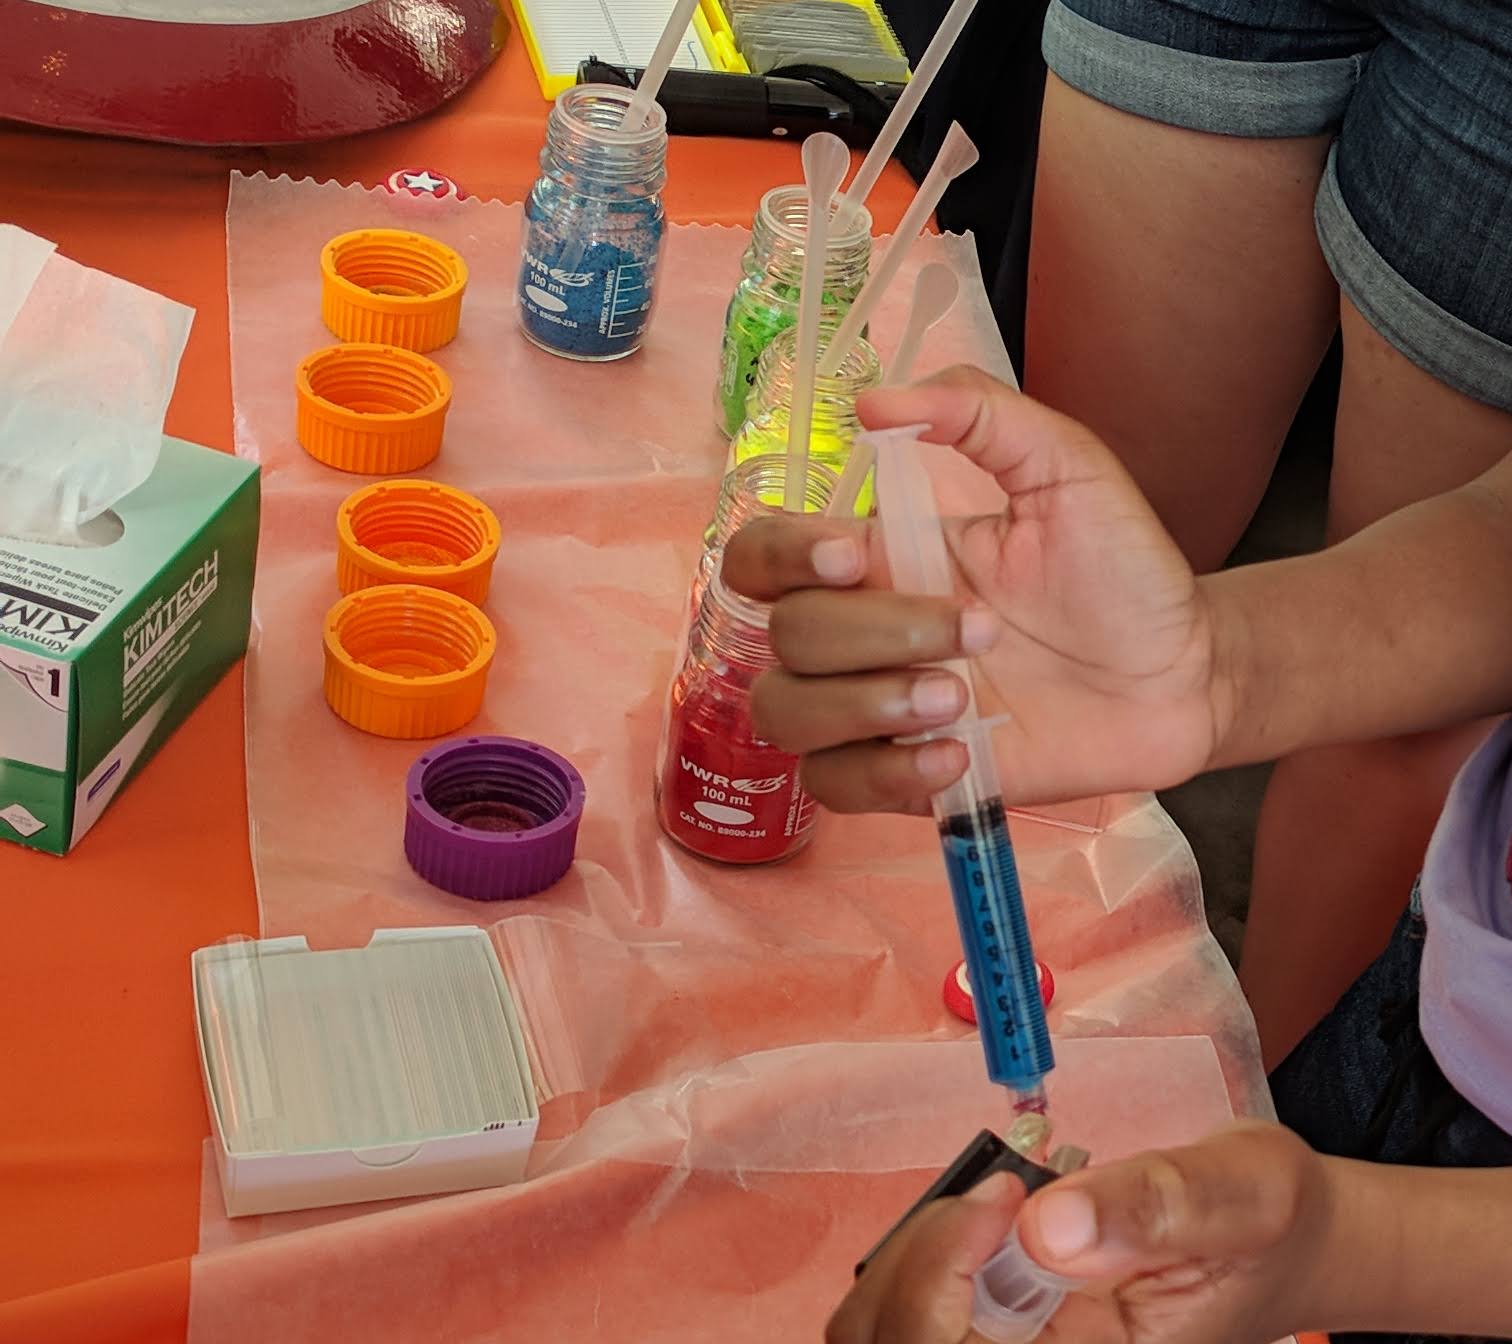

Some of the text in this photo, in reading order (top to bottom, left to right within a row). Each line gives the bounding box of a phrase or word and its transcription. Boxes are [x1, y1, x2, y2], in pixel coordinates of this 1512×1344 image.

[530, 271, 566, 296] 100 mL
[36, 582, 60, 597] Task
[62, 590, 108, 612] Delicate
[123, 548, 219, 673] KIMTECH
[47, 668, 61, 698] 1
[680, 755, 730, 788] VWR
[701, 786, 753, 807] 100 mL
[698, 821, 715, 833] NO.
